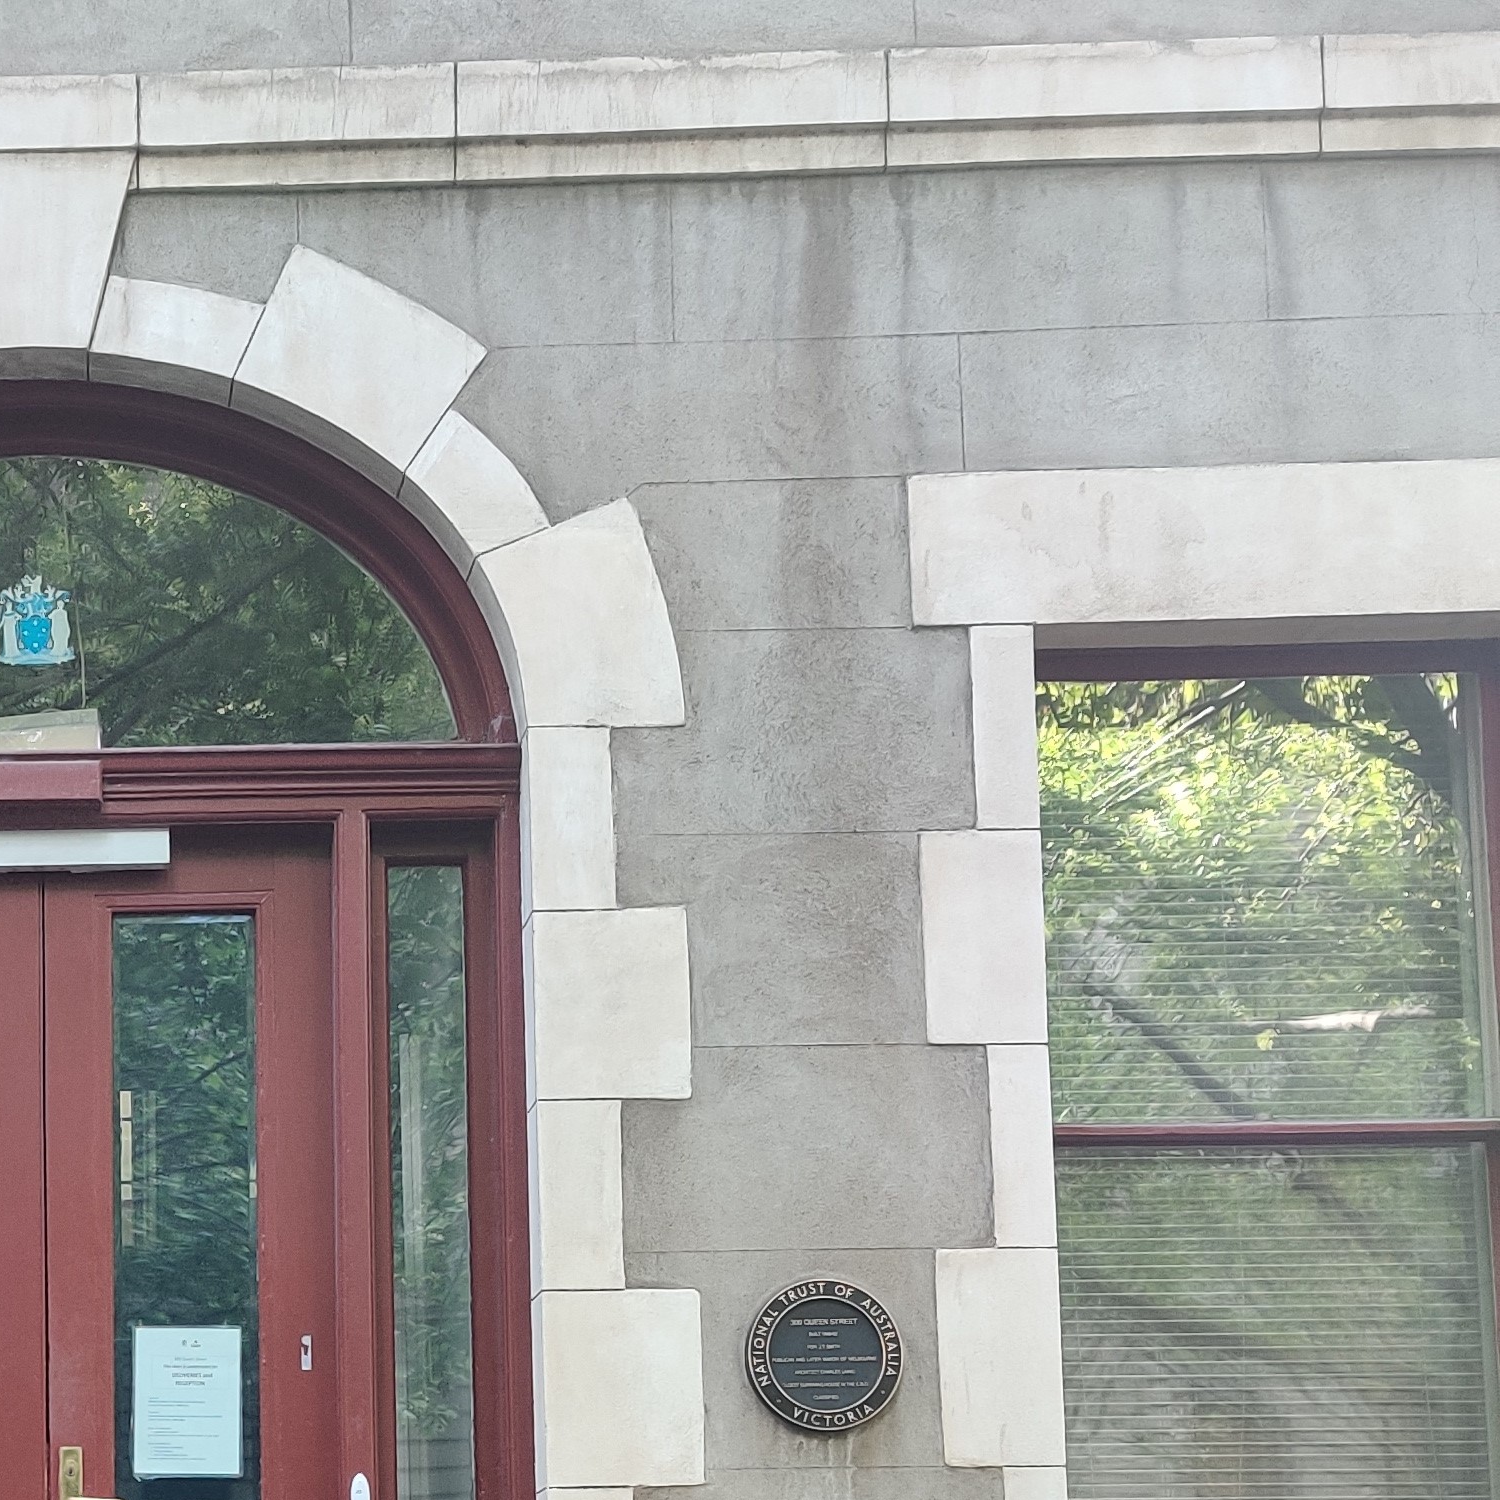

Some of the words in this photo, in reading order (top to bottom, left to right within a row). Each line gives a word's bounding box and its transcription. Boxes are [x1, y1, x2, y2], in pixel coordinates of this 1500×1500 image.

[752, 1309, 779, 1387] NATIONAL
[778, 1282, 827, 1306] TRUST
[834, 1284, 855, 1299] OF
[860, 1298, 900, 1377] AUSTRALIA
[792, 1403, 875, 1427] VICTORIA
